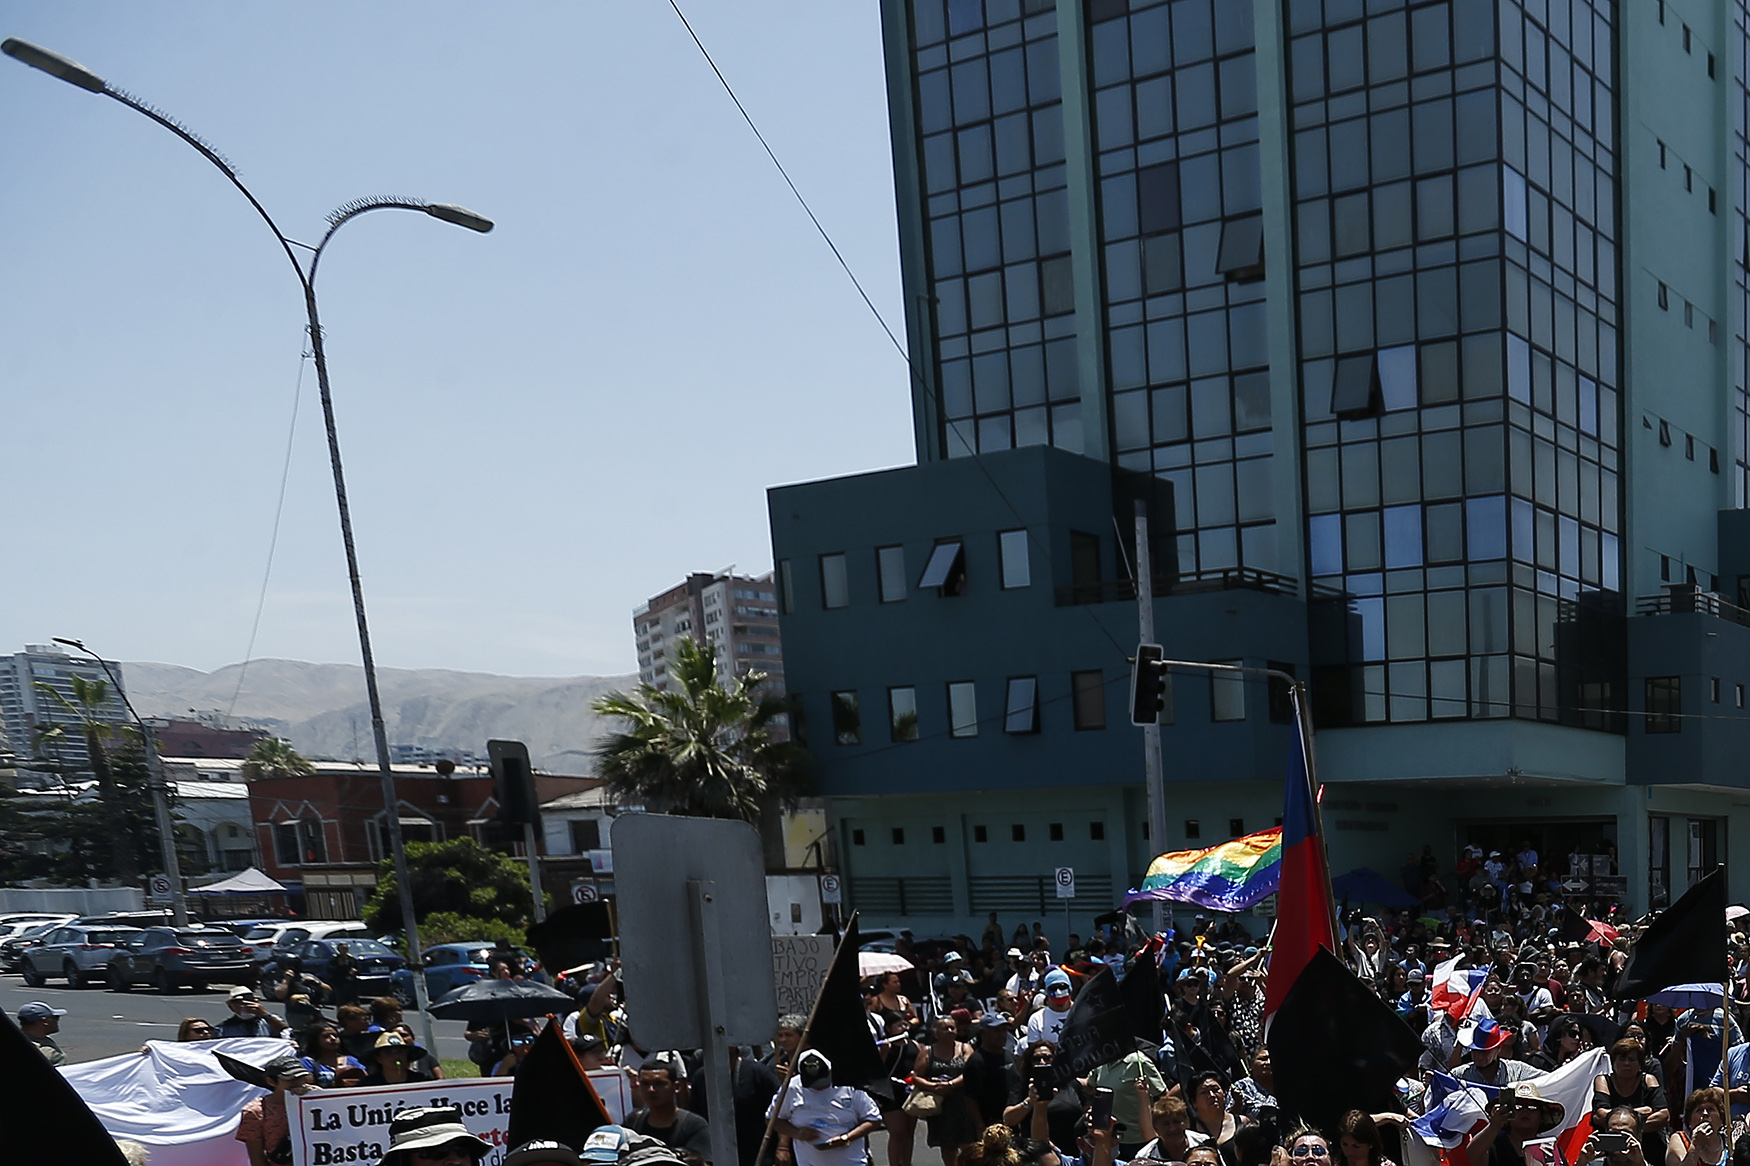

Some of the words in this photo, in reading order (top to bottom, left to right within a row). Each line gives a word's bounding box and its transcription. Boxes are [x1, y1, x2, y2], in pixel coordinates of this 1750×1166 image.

[1061, 872, 1068, 883] E
[311, 1108, 342, 1131] La
[312, 1140, 384, 1166] Basta
